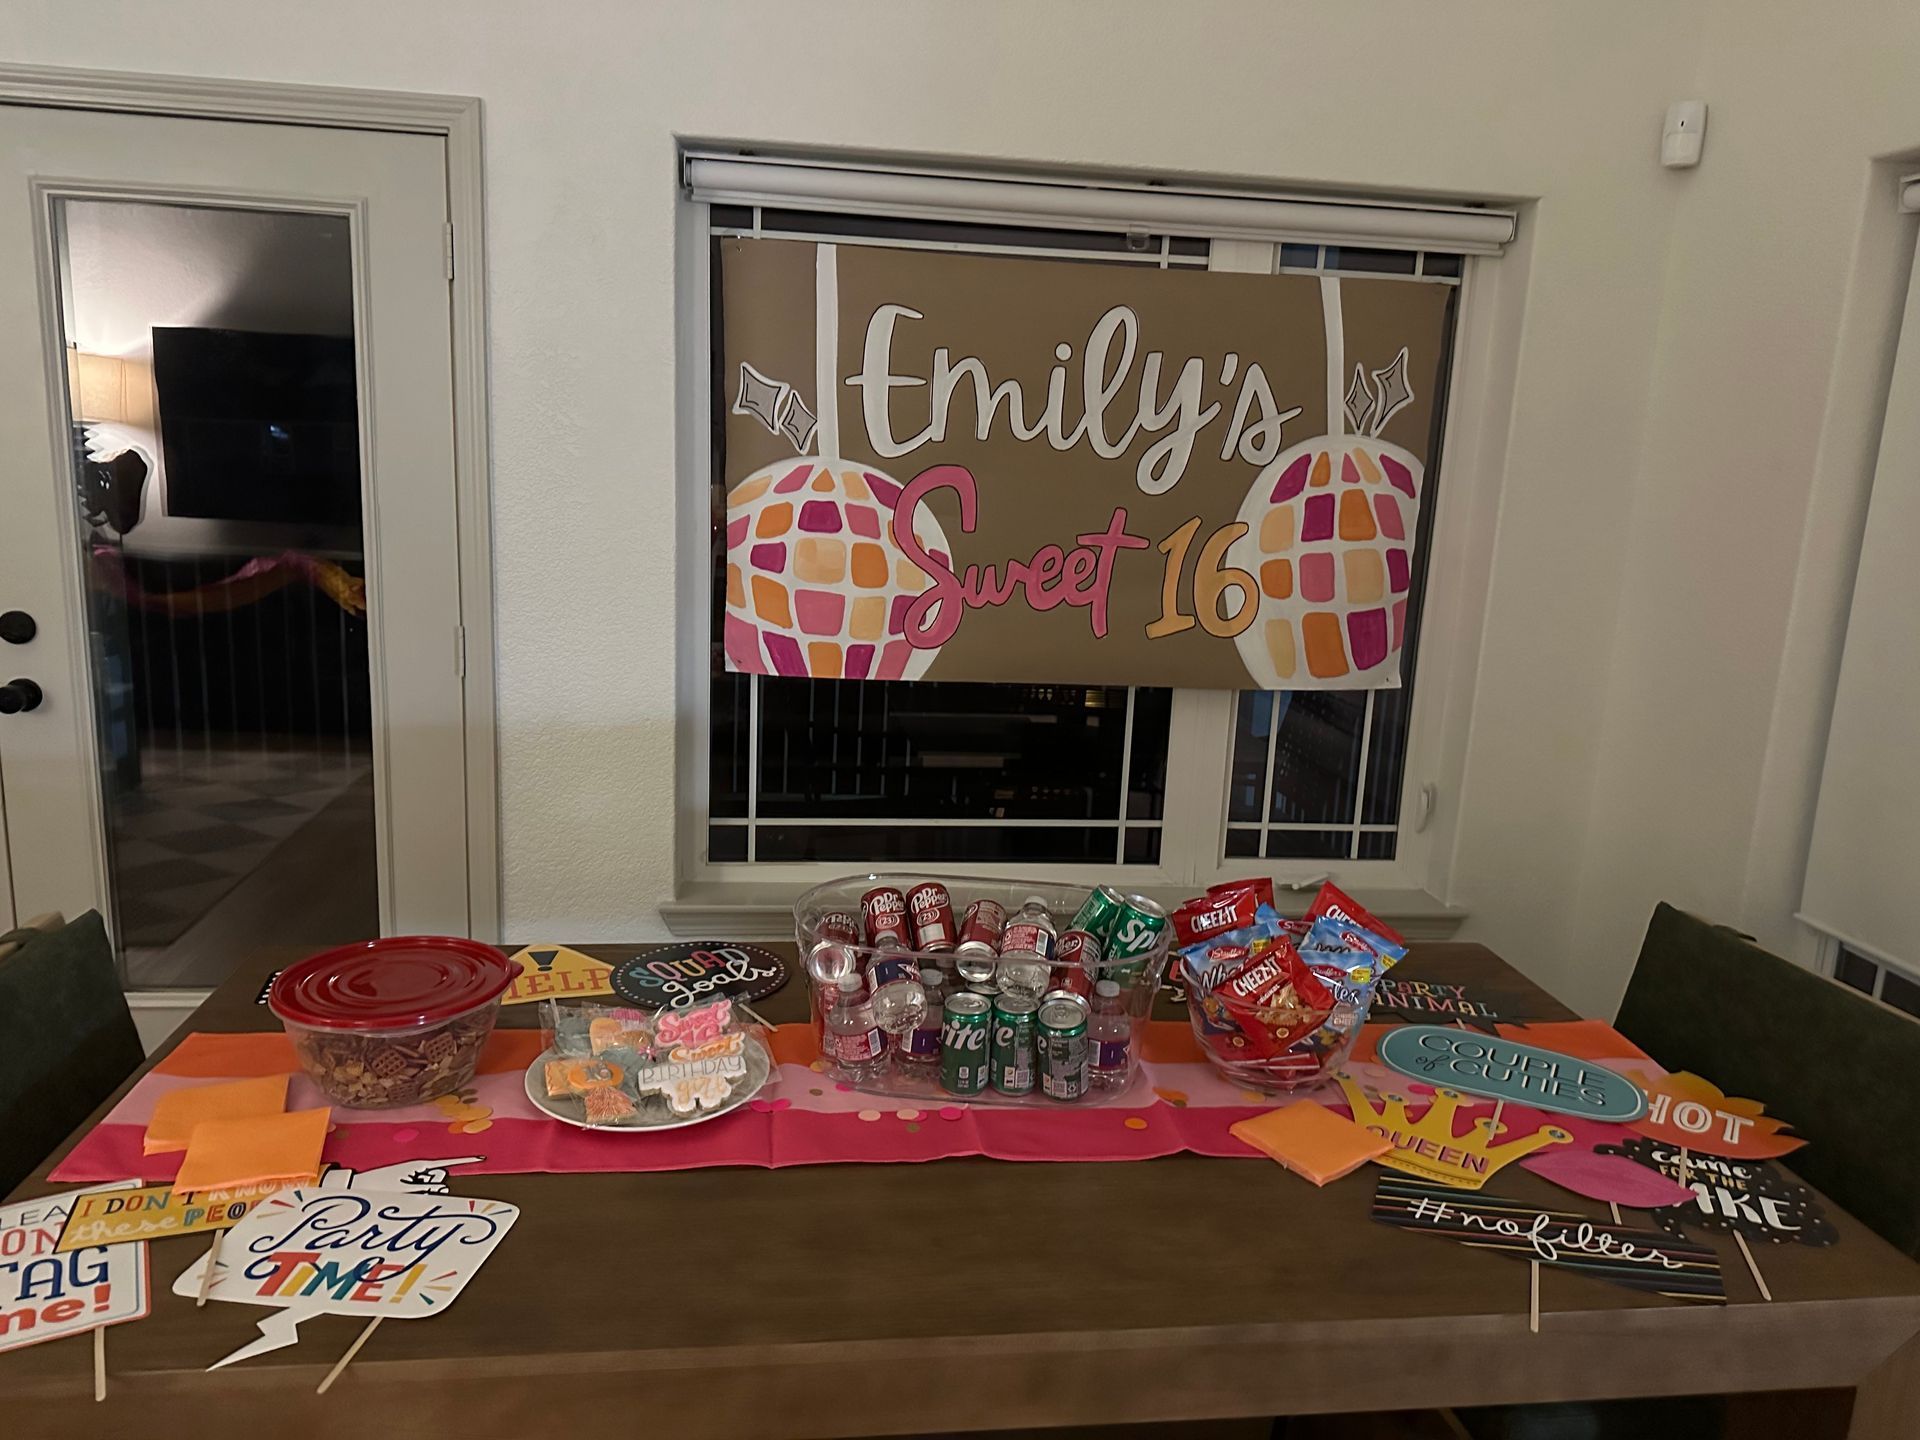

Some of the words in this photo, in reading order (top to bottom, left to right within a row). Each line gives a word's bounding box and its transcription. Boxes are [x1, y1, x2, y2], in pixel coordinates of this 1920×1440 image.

[845, 304, 1302, 496] Emily's
[892, 464, 1150, 651] Sweet
[1145, 516, 1260, 641] 16
[629, 949, 750, 989] SQUAD
[662, 959, 777, 1009] goals
[1381, 980, 1466, 1000] PARTY
[1415, 1054, 1450, 1072] of
[1450, 1059, 1606, 1106] CUTIES
[1418, 1033, 1606, 1087] COUPLE
[1645, 1091, 1754, 1145] HOT
[1704, 1171, 1748, 1191] THE
[69, 1214, 179, 1243] these
[80, 1199, 96, 1218] I
[1407, 1197, 1684, 1269] #nofilter
[244, 1195, 497, 1283] Party
[255, 1251, 428, 1304] TIME!
